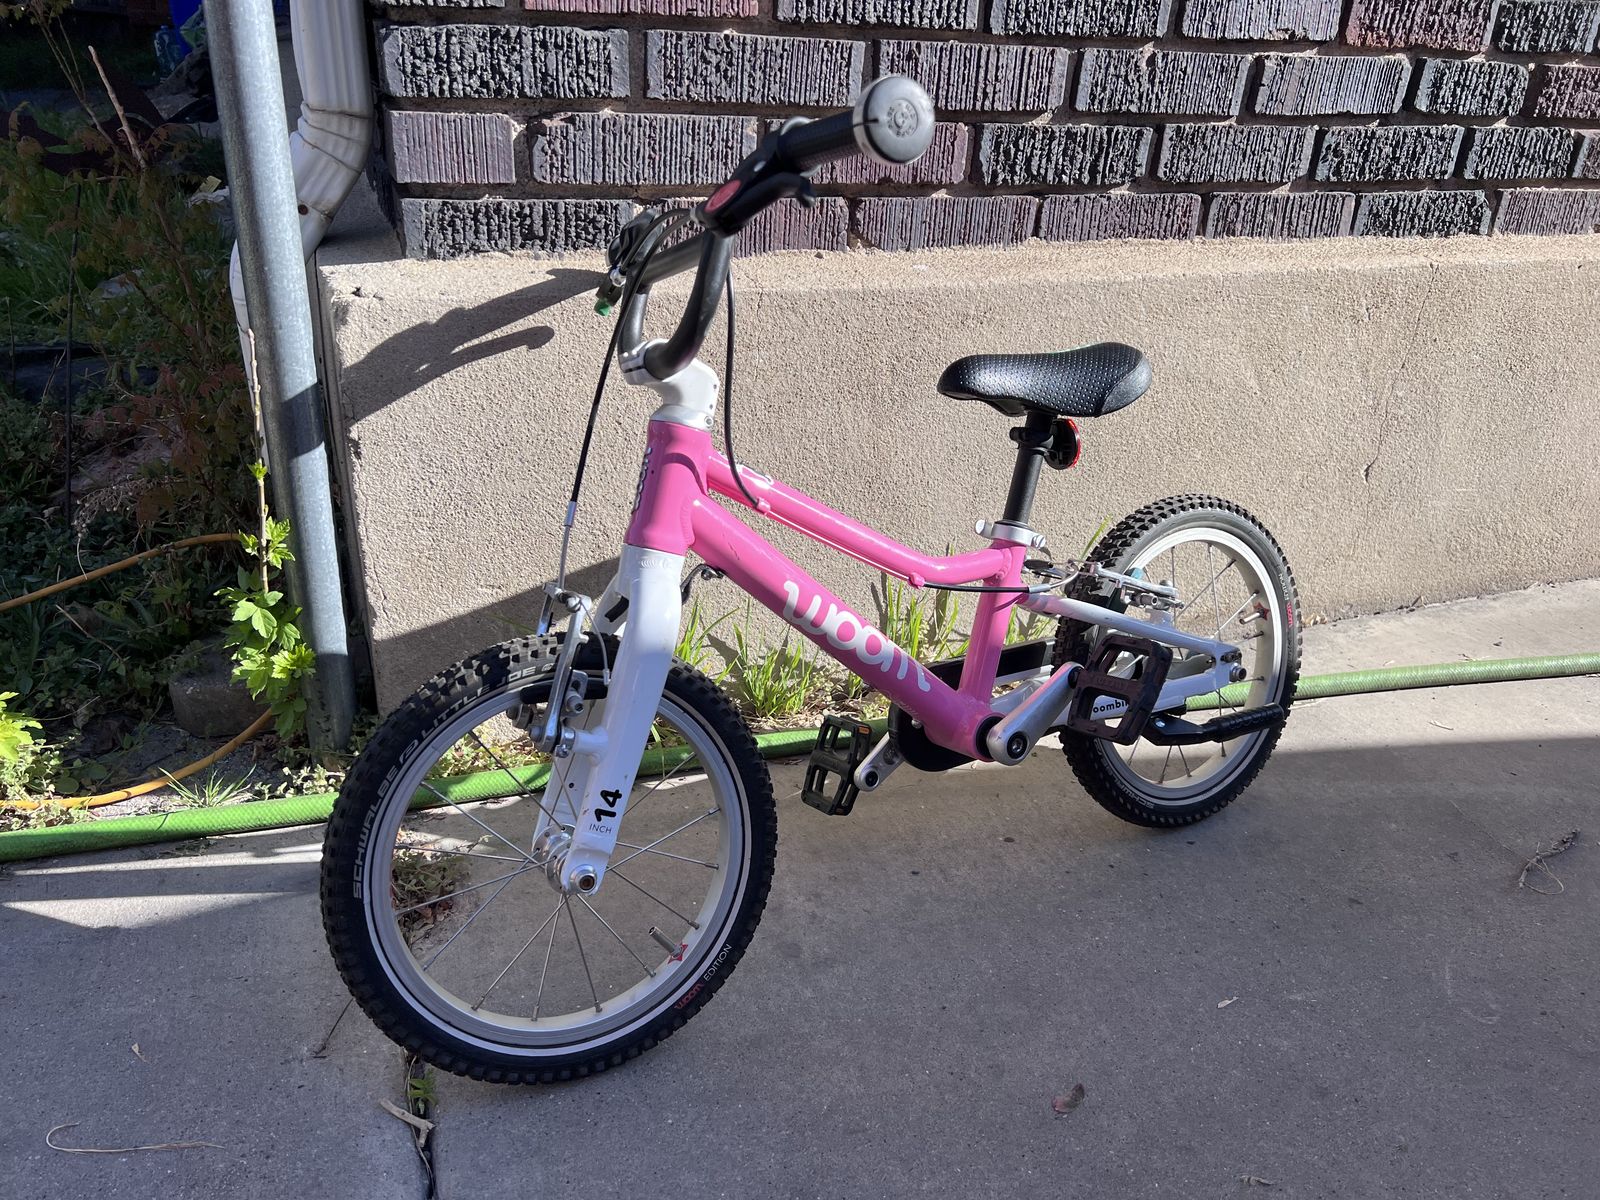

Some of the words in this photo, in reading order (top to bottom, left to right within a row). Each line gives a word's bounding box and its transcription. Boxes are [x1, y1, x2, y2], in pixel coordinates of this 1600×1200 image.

[783, 580, 931, 692] woom
[352, 765, 398, 899] SCHWALBE
[422, 683, 490, 739] LITTLE
[594, 789, 623, 822] 14
[588, 823, 612, 834] INCH
[673, 982, 705, 1010] woom
[703, 943, 732, 981] EDITION
